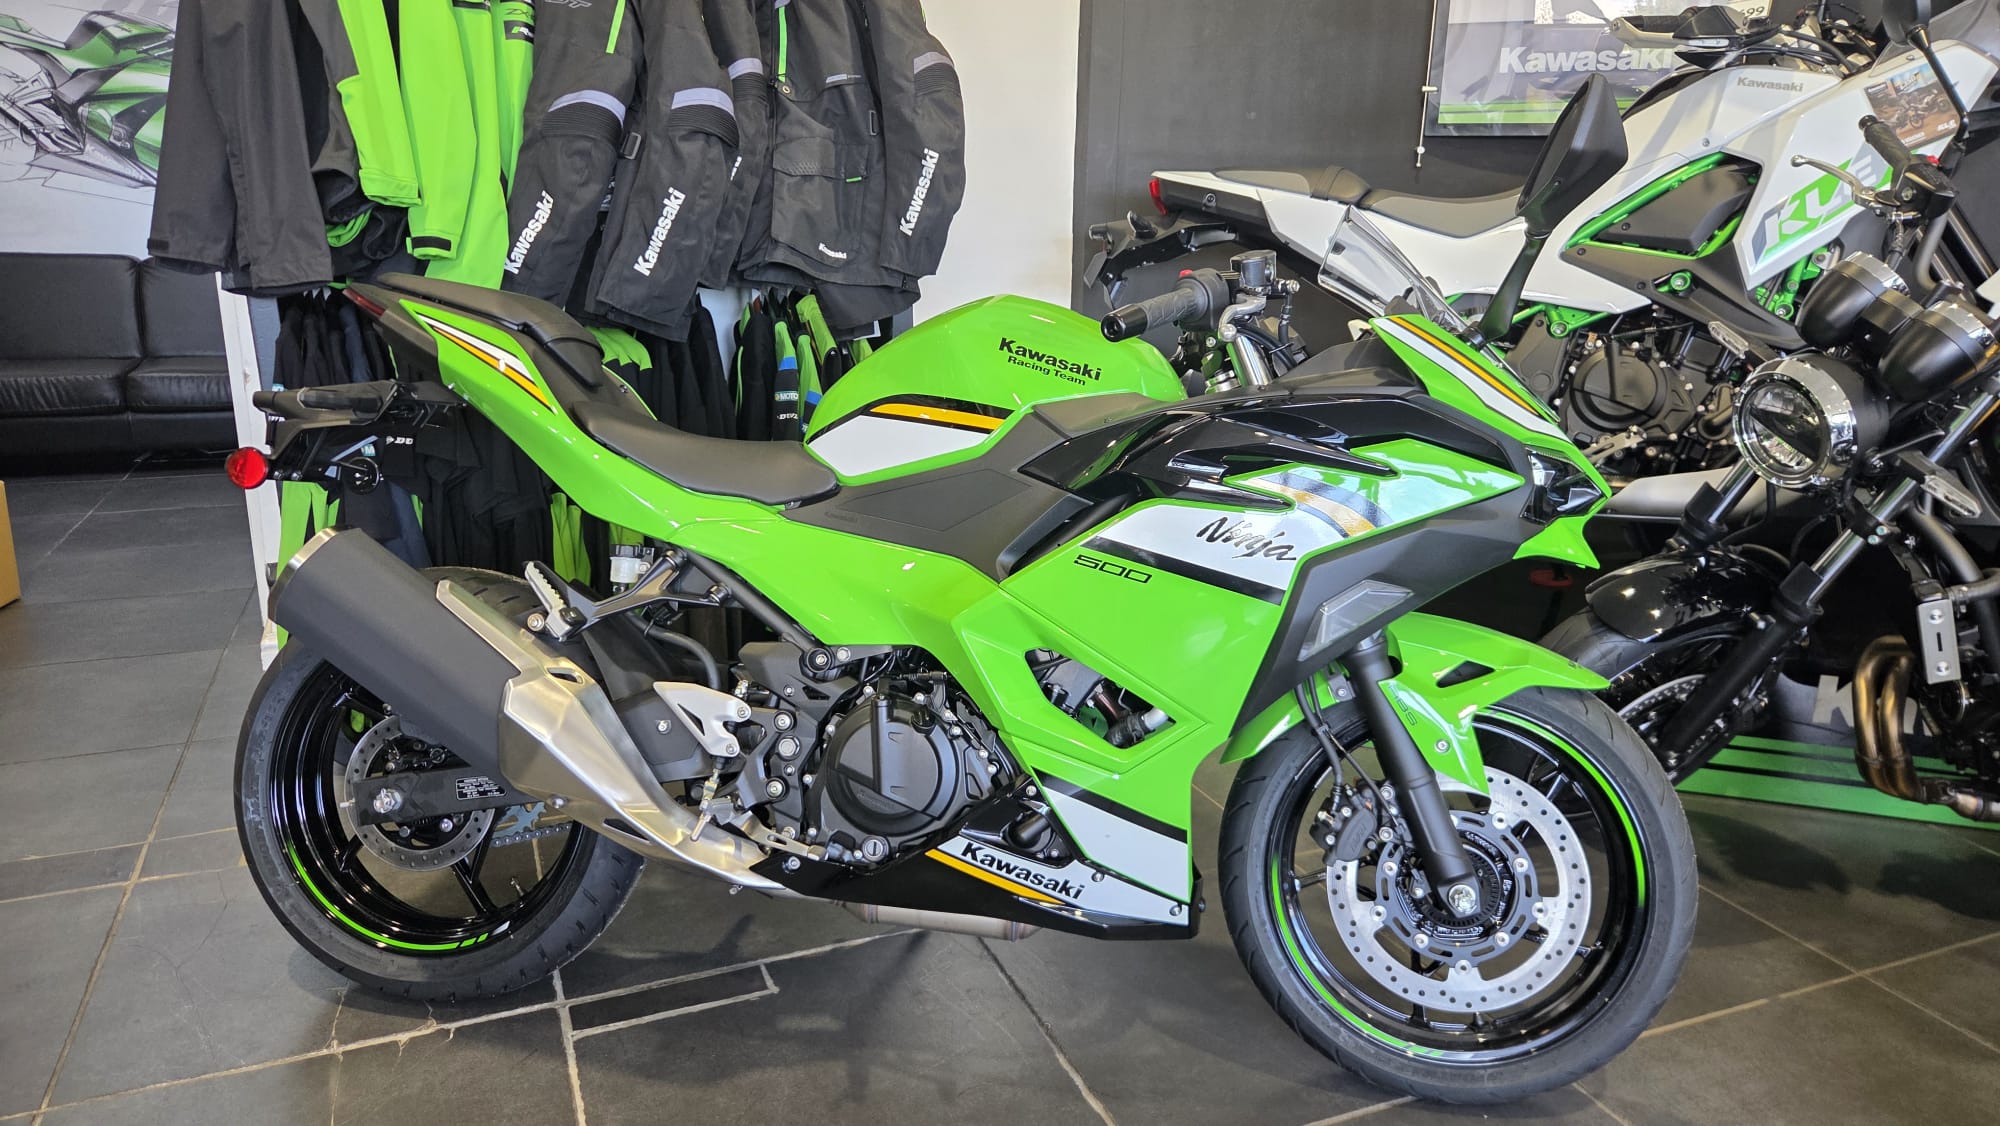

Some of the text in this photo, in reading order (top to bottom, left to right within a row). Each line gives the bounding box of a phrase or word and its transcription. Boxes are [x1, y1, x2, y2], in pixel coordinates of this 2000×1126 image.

[1499, 46, 1674, 74] Kawasaki
[1736, 76, 1804, 93] Kawasaki
[899, 147, 940, 237] Kawasaki
[503, 189, 554, 275] Kawasaki
[633, 186, 686, 277] Kawasaki
[999, 337, 1102, 381] Kawasaki
[1007, 355, 1086, 386] Racing Team
[1196, 517, 1297, 561] Ninja
[1073, 553, 1153, 584] 500
[961, 842, 1085, 900] Kawasaki
